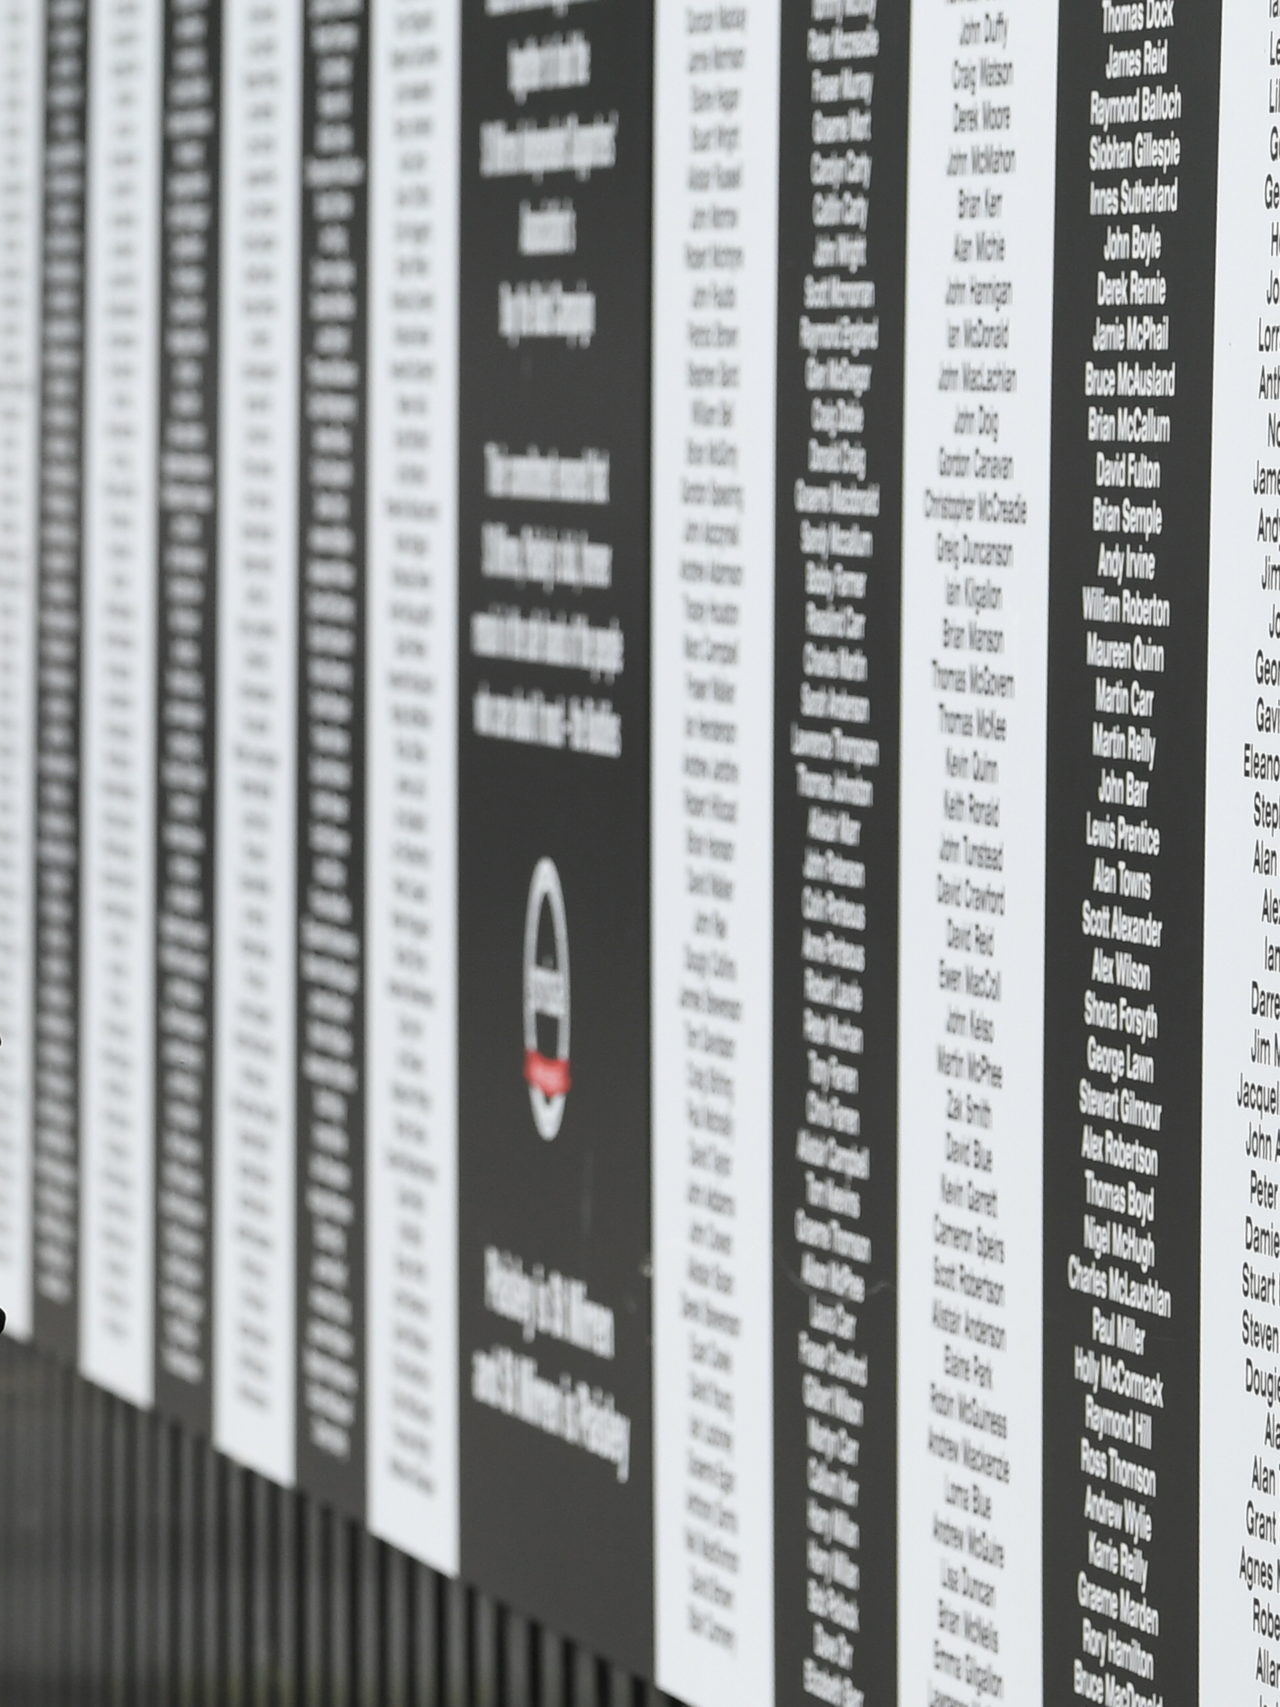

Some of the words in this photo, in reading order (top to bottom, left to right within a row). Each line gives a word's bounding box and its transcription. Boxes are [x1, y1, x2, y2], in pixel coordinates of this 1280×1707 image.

[1102, 0, 1143, 33] Thomas
[1146, 0, 1174, 30] Dock
[1106, 44, 1141, 80] James
[1144, 39, 1167, 75] Reid
[1091, 87, 1139, 133] Raymond
[1142, 83, 1181, 122] Balloch
[1090, 135, 1132, 171] Siobhan
[1135, 130, 1180, 174] Gillespie
[1090, 181, 1118, 216] Innes
[1121, 177, 1178, 215] Sutherland
[1104, 225, 1129, 260] John
[1132, 224, 1161, 267] Boyle
[1098, 270, 1127, 306] Derek
[1130, 269, 1166, 305] Rennie
[1093, 316, 1124, 352] Jamie
[1127, 315, 1168, 351] McPhail
[1085, 360, 1115, 396] Bruce
[1117, 361, 1175, 397] McAusland
[1088, 406, 1115, 442] Brian
[1117, 406, 1170, 443] McCallum
[1096, 451, 1126, 487] David
[1128, 452, 1160, 489] Fulton
[1093, 496, 1120, 532] Brian
[1123, 497, 1162, 541] Semple
[1098, 543, 1124, 586] Andy
[1126, 543, 1155, 580] Irvine
[1083, 586, 1120, 622] William
[1122, 589, 1170, 627] Roberton
[1087, 631, 1131, 669] Maureen
[1133, 634, 1164, 673] Quinn
[1096, 677, 1128, 714] Martin
[1131, 680, 1154, 717] Carr
[1093, 721, 1125, 759] Martin
[1128, 725, 1156, 771] Reilly
[1099, 768, 1124, 804] John
[1126, 771, 1148, 808] Barr
[1087, 811, 1115, 849] Lewis
[1118, 815, 1160, 856] Prentice
[1093, 857, 1116, 894] Alan
[1120, 861, 1151, 901] Towns
[1253, 840, 1278, 876] Alan
[1082, 899, 1109, 939] Scott
[1112, 905, 1162, 948] Alexander
[1092, 947, 1113, 985] Alex
[1116, 951, 1150, 991] Wilson
[1085, 989, 1117, 1030] Shona
[1119, 996, 1157, 1044] Forsyth
[1087, 1035, 1124, 1084] George
[1127, 1044, 1154, 1084] Lawn
[1251, 1029, 1271, 1066] Jim
[1080, 1078, 1118, 1122] Stewart
[1121, 1088, 1162, 1131] Gilmour
[1082, 1125, 1103, 1162] Alex
[1105, 1129, 1158, 1176] Robertson
[1246, 1122, 1272, 1160] John
[1085, 1168, 1125, 1214] Thomas
[1128, 1180, 1154, 1227] Boyd
[1249, 1170, 1279, 1210] Peter
[1084, 1214, 1110, 1260] Nigel
[1112, 1222, 1154, 1274] McHugh
[1068, 1254, 1107, 1299] Charles
[1109, 1265, 1171, 1318] McLauchlan
[1242, 1262, 1276, 1305] Stuart
[1093, 1306, 1115, 1346] Paul
[1117, 1314, 1145, 1356] Miller
[1242, 1309, 1280, 1353] Steven
[1075, 1345, 1099, 1394] Holly
[1101, 1354, 1163, 1408] McCormack
[1086, 1393, 1133, 1444] Raymond
[1135, 1411, 1151, 1450] Hill
[1081, 1437, 1107, 1480] Ross
[1110, 1447, 1156, 1497] Thomson
[1251, 1456, 1276, 1496] Alan
[1085, 1484, 1122, 1530] Andrew
[1125, 1498, 1152, 1545] Wylie
[1246, 1500, 1277, 1544] Grant
[1120, 1542, 1148, 1593] Reilly
[1239, 1546, 1274, 1591] Agnes
[1078, 1570, 1118, 1620] Graeme
[1083, 1617, 1106, 1667] Rory
[1108, 1628, 1153, 1681] Hamilton
[1074, 1658, 1103, 1694] Bruce
